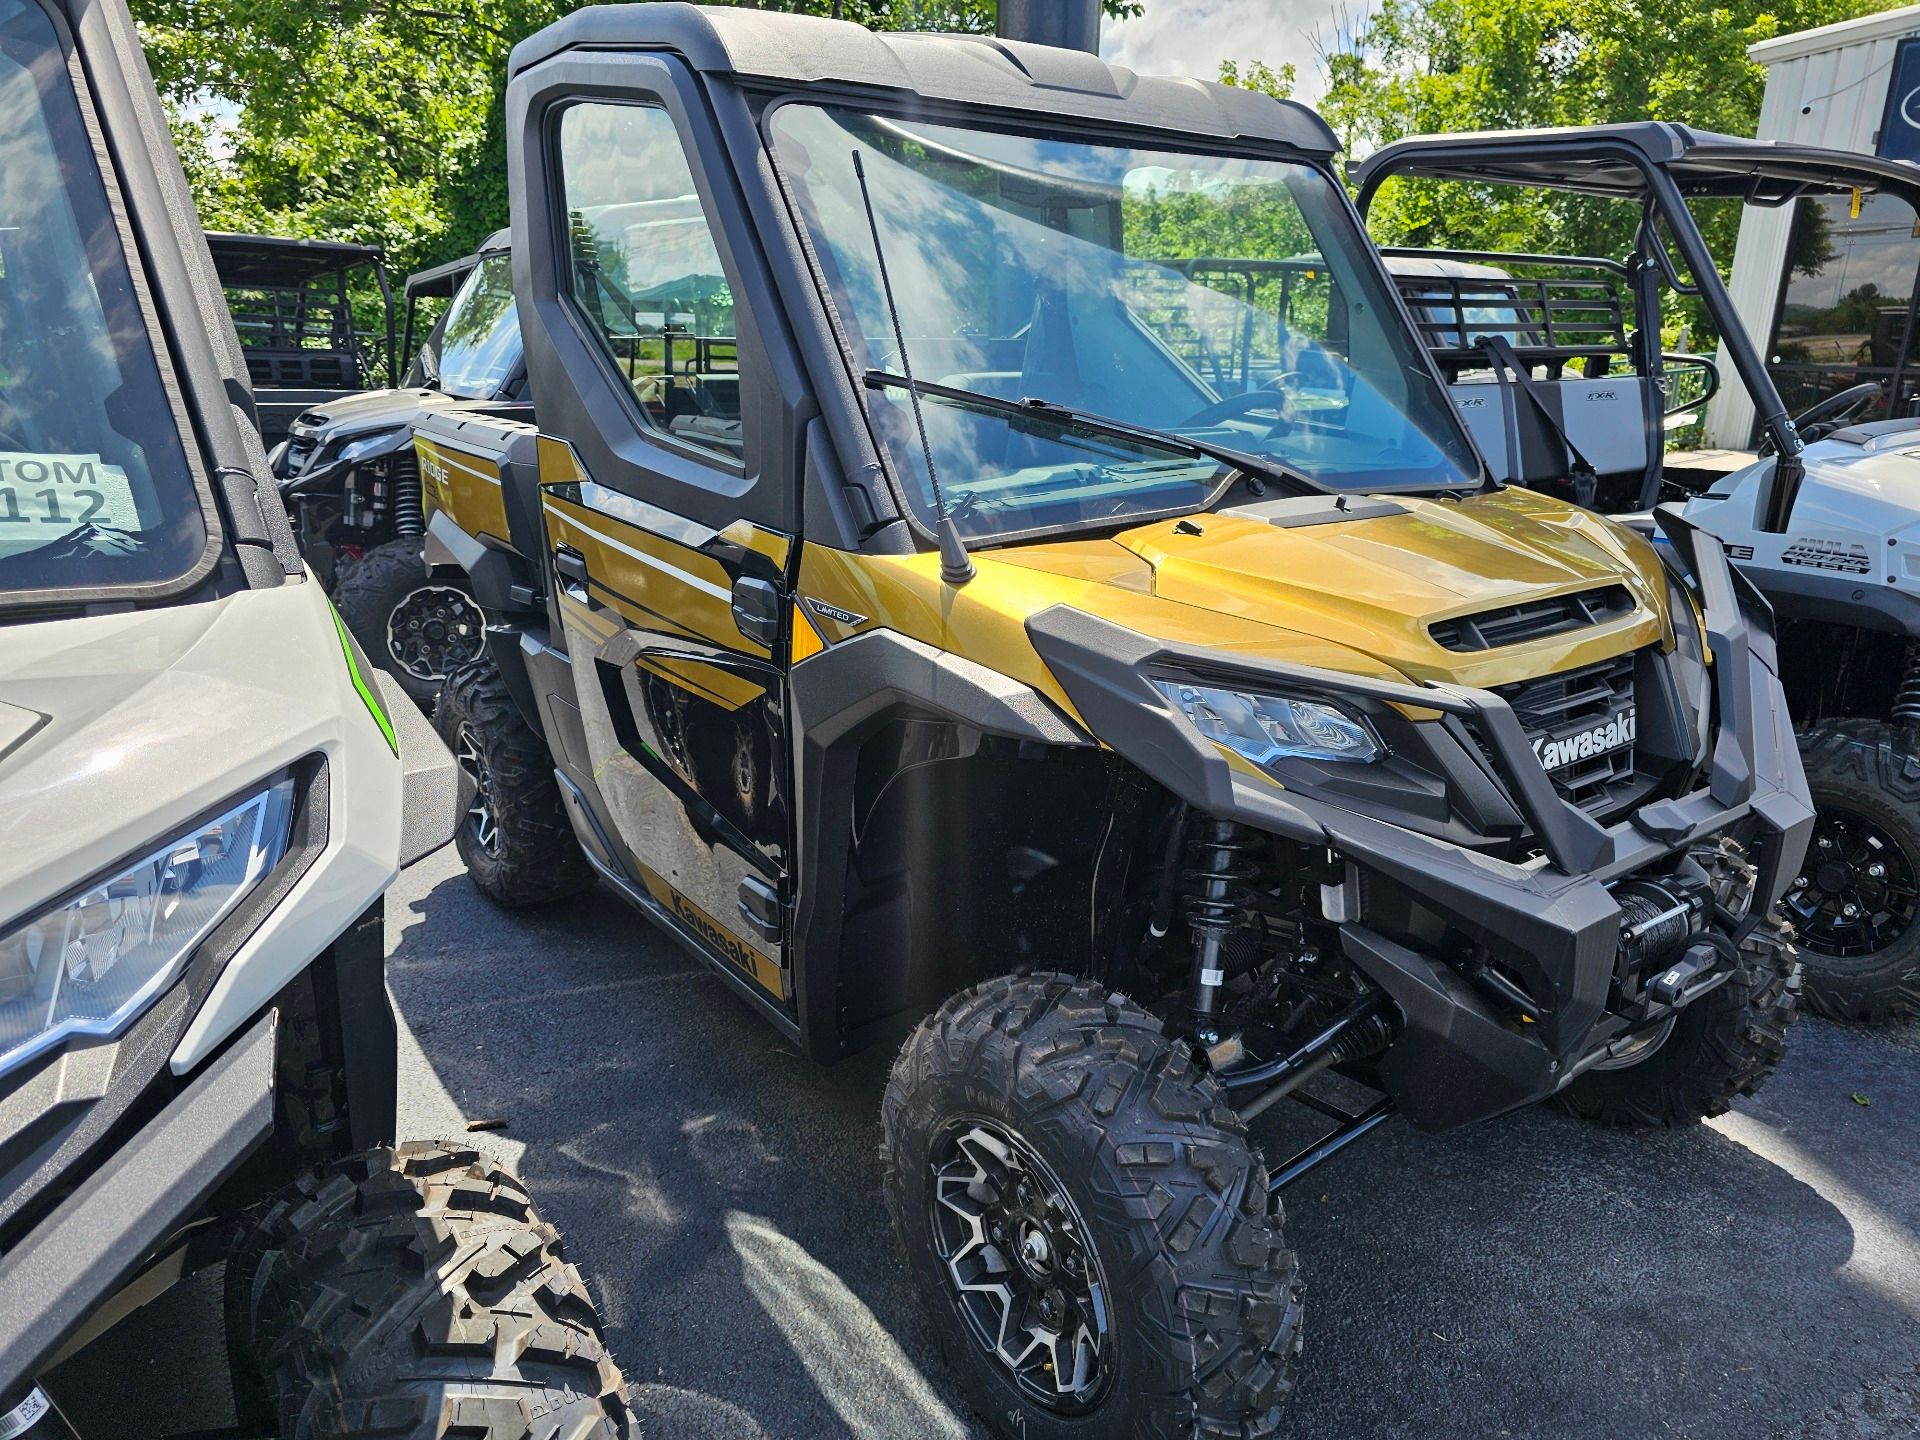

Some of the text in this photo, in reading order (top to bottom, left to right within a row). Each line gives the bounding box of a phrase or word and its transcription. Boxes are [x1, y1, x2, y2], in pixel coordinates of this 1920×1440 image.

[421, 456, 449, 485] RIDGE
[816, 604, 849, 621] LIMITED
[670, 889, 758, 978] Kawasaki
